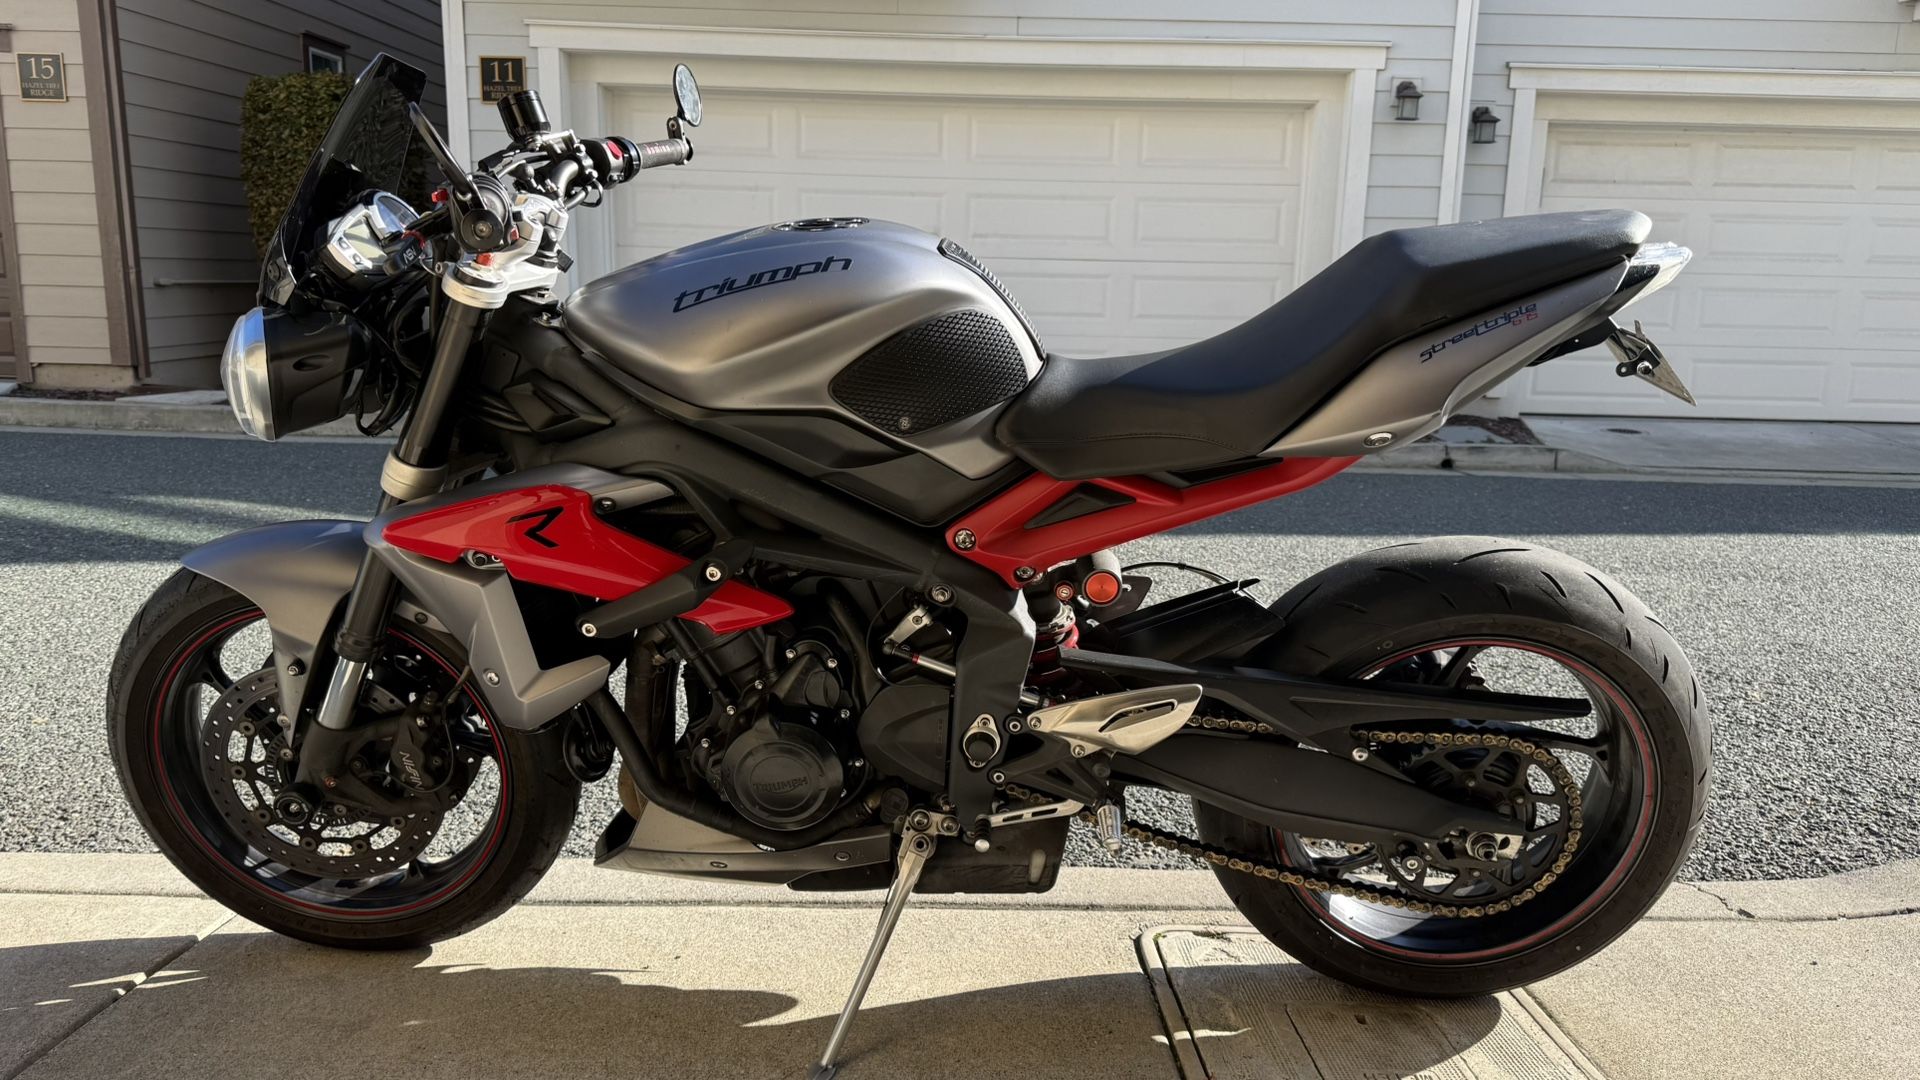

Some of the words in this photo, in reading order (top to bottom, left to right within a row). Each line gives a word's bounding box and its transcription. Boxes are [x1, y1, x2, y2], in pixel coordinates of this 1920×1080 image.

[26, 57, 55, 80] 15
[489, 61, 517, 82] 11
[30, 89, 55, 97] RIDGE
[673, 256, 852, 313] triumph
[752, 776, 809, 793] TRIUMPH
